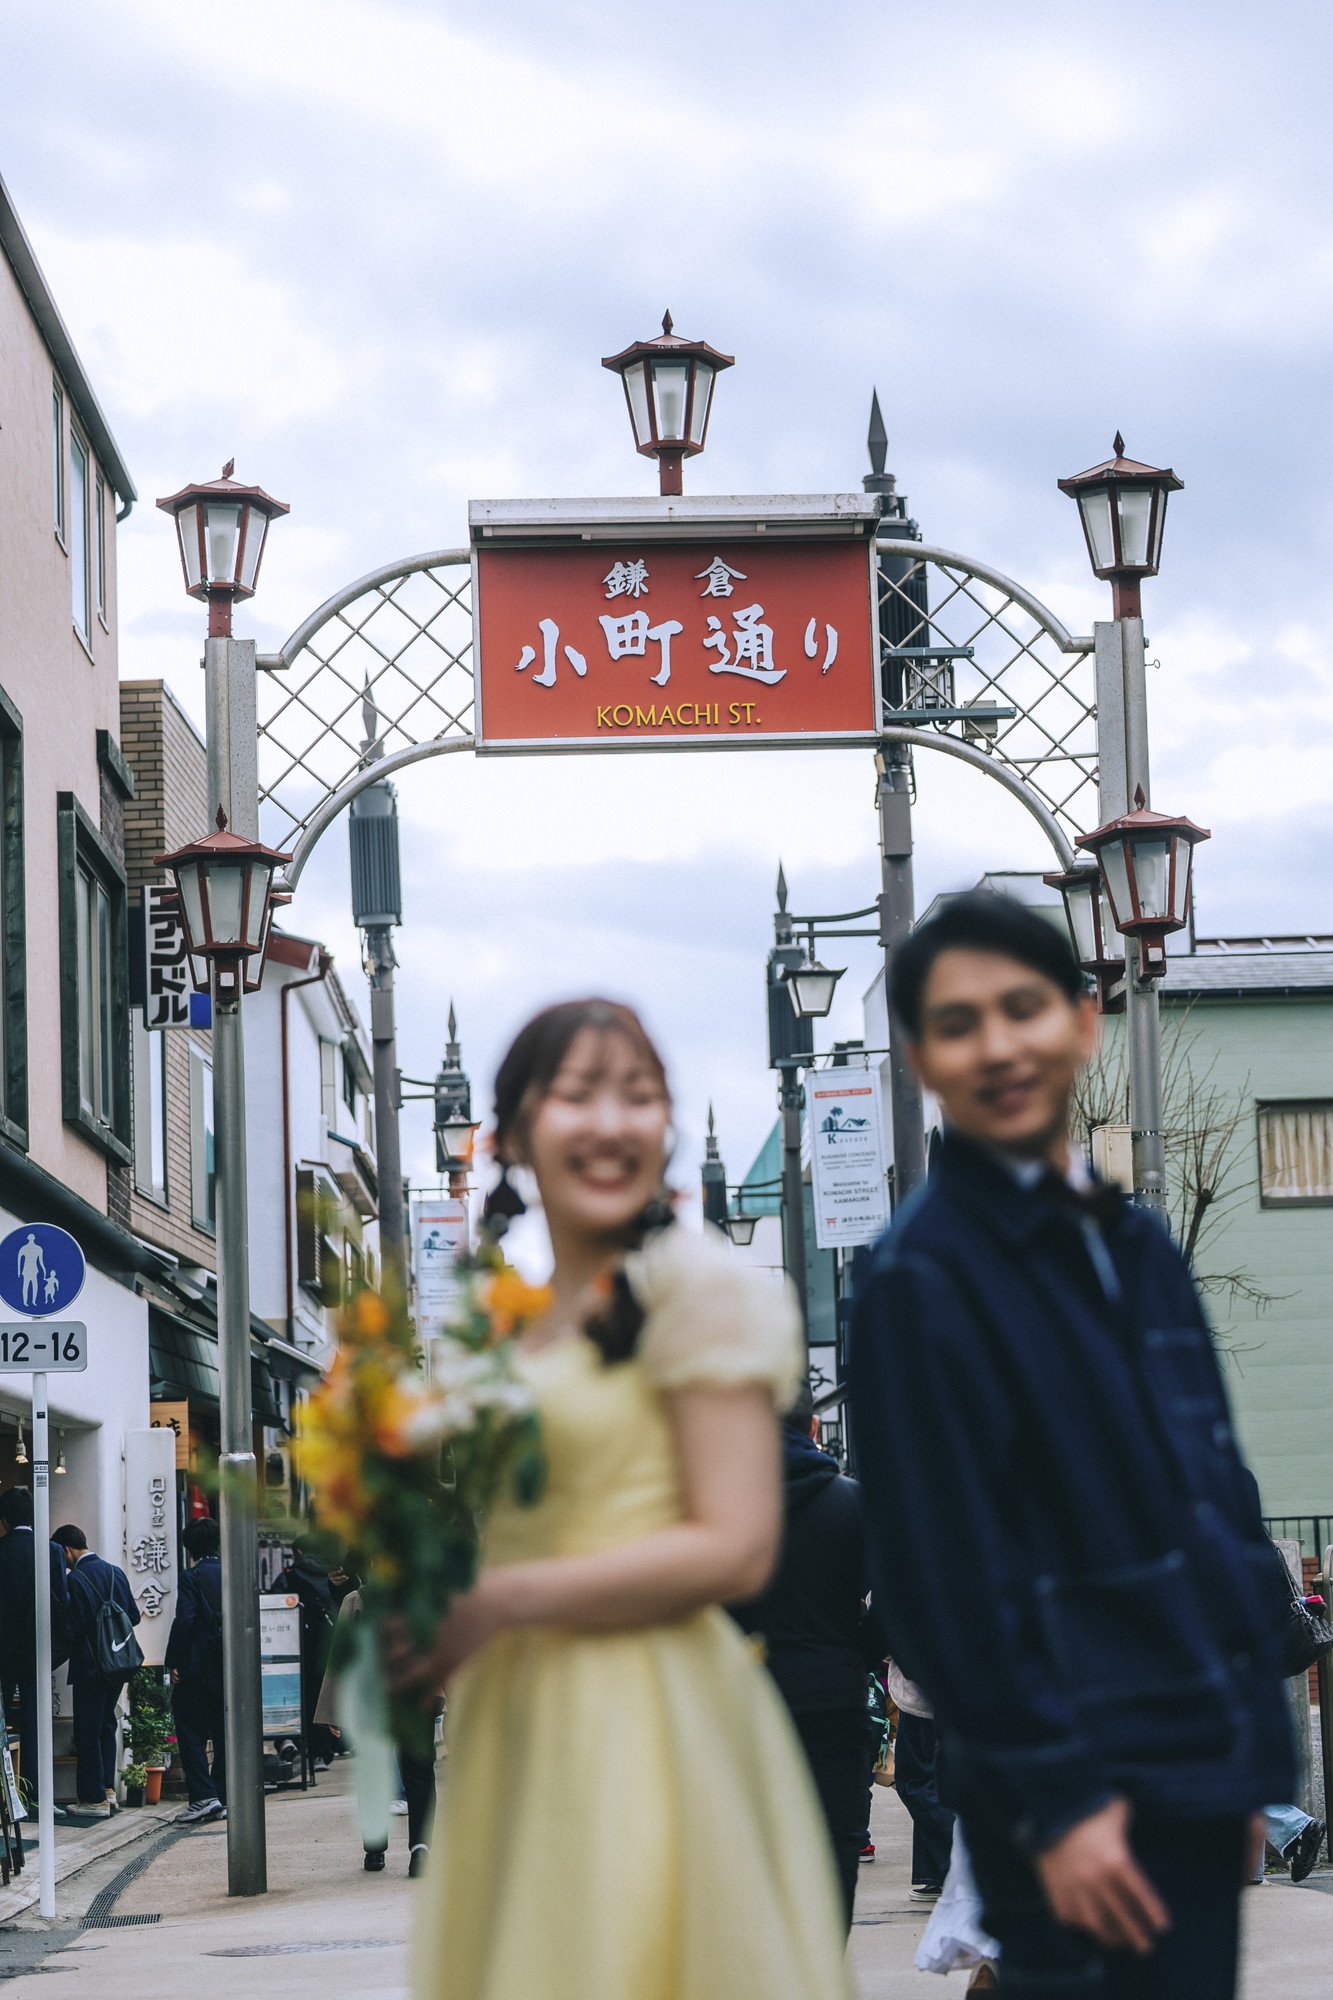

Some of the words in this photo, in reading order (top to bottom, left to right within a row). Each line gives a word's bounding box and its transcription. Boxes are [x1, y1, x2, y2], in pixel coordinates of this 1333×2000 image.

[602, 555, 748, 599] 鎌倉
[514, 602, 839, 688] 小町通り
[596, 703, 720, 728] KOMACHI
[729, 702, 762, 726] ST.
[828, 1133, 837, 1144] K
[1, 1332, 80, 1362] 12-16
